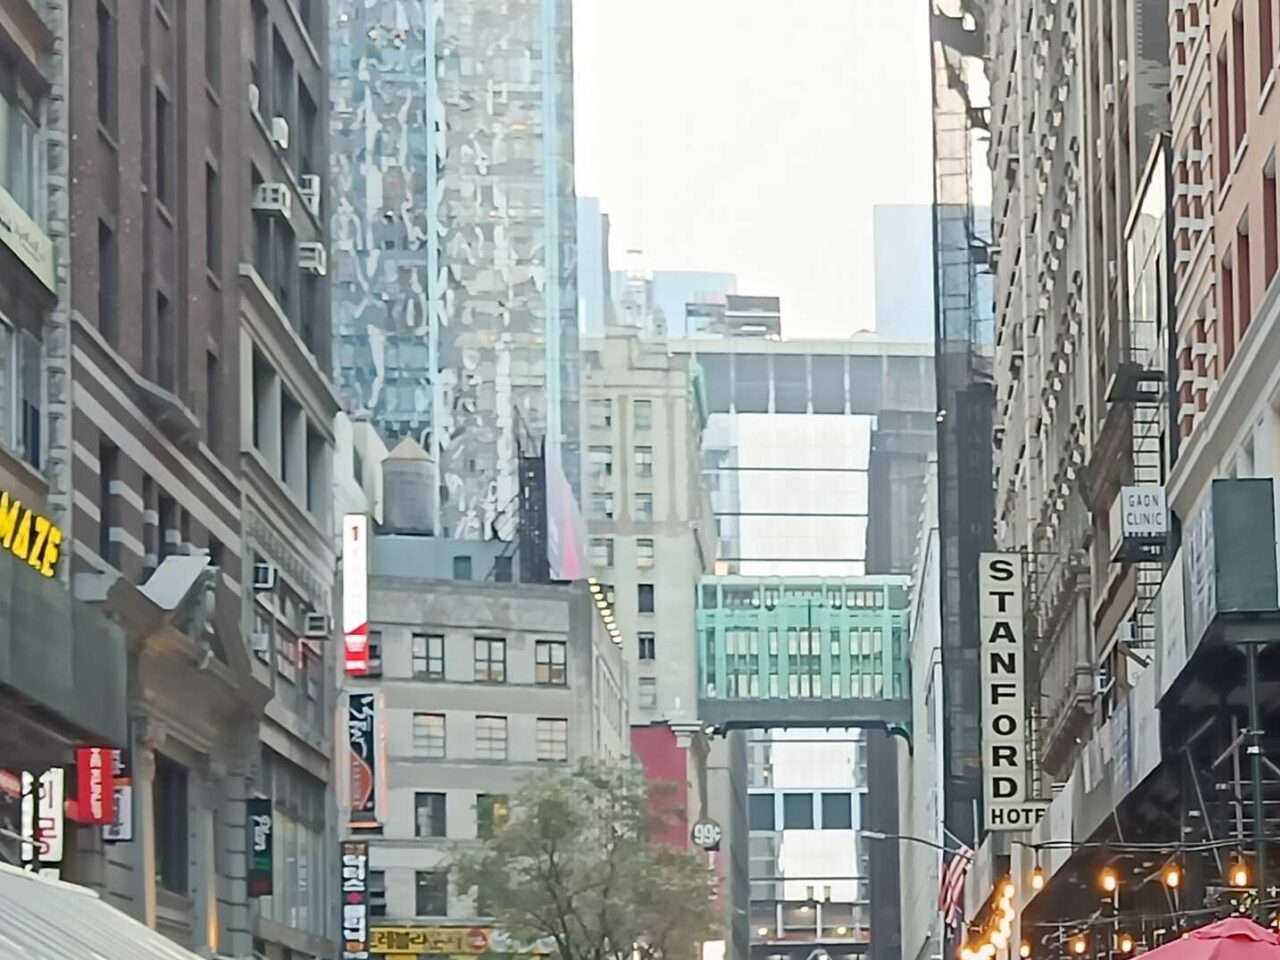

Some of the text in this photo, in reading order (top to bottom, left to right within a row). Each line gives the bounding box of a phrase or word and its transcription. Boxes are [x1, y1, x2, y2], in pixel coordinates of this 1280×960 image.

[1128, 494, 1159, 507] GAON
[1126, 512, 1162, 526] CLINIC
[988, 559, 1019, 799] STANFORD
